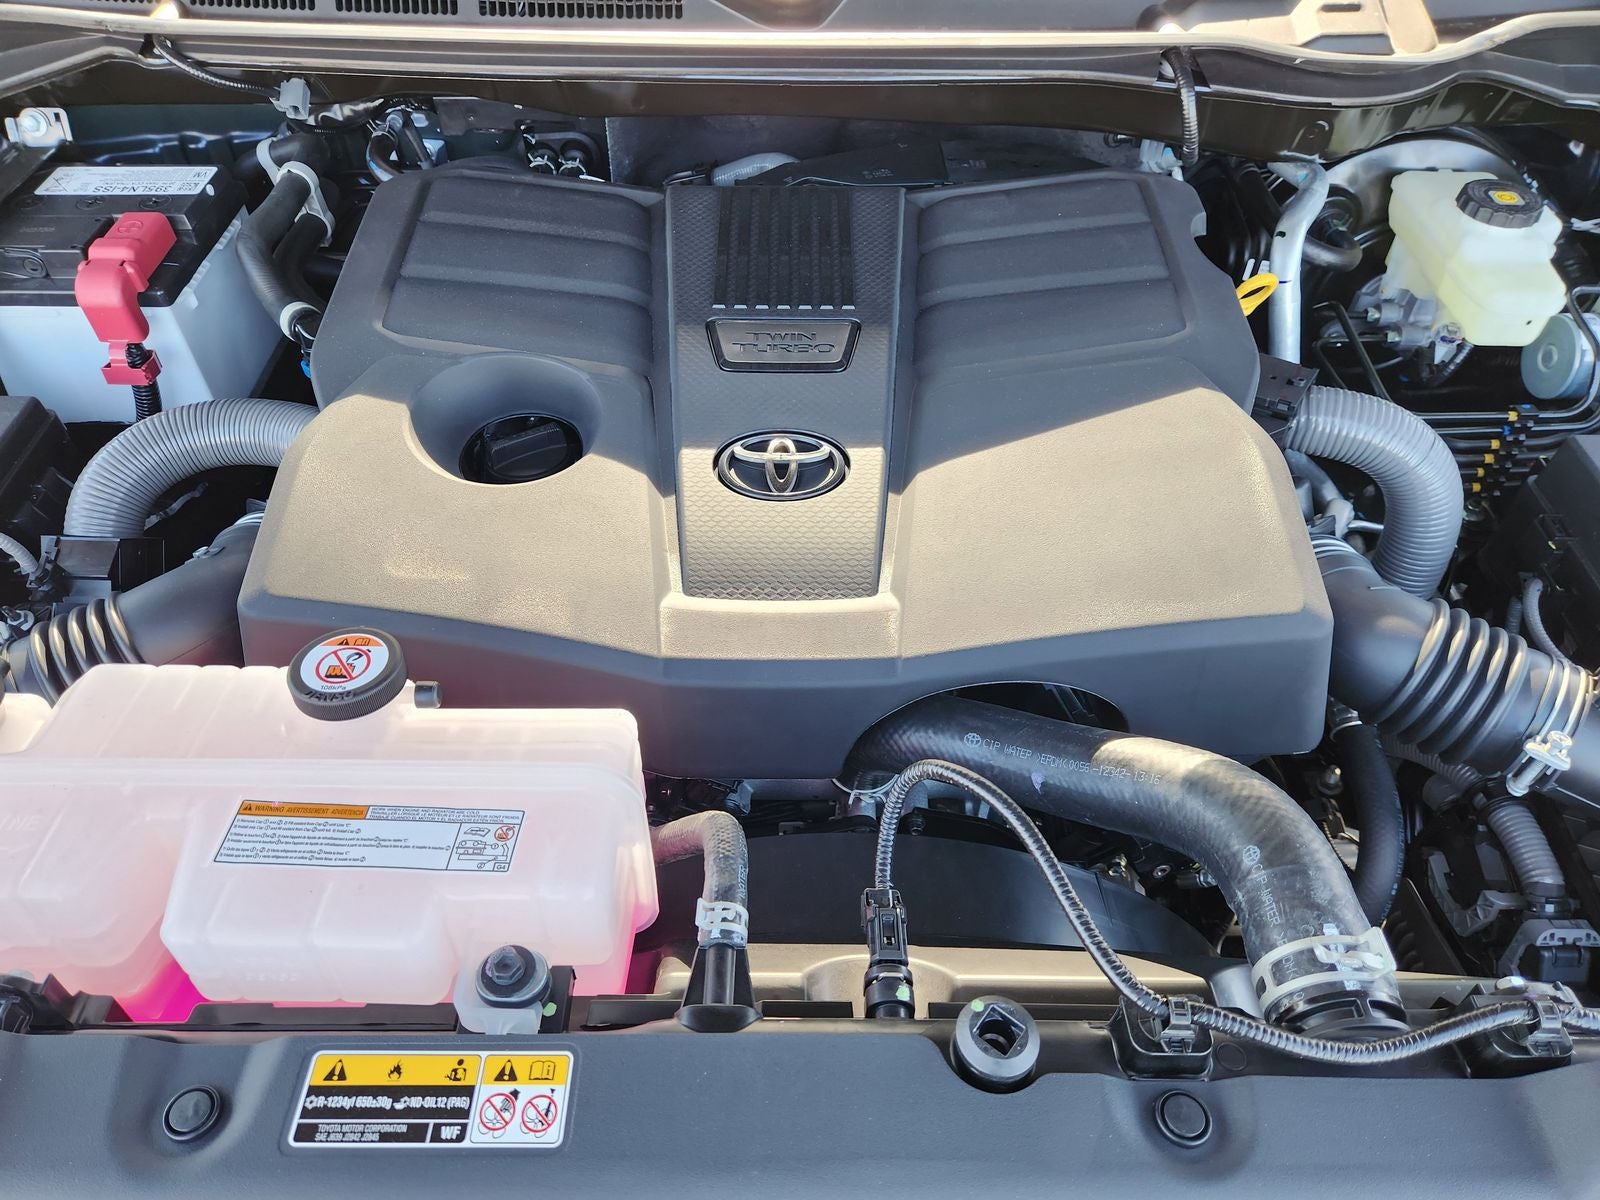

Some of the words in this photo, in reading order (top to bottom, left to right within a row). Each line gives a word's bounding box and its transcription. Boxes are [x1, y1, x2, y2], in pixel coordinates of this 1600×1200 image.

[745, 332, 816, 341] TWIN
[731, 343, 836, 353] TURBO
[1004, 744, 1034, 761] WATER
[255, 804, 284, 813] WARNING
[1259, 887, 1282, 927] WATER
[447, 1096, 470, 1110] (PAG)
[318, 1124, 341, 1133] TOYOTA
[341, 1124, 364, 1133] MOTOR
[364, 1124, 408, 1134] CORPORATION
[440, 1125, 462, 1140] WF
[315, 1133, 328, 1142] SAE
